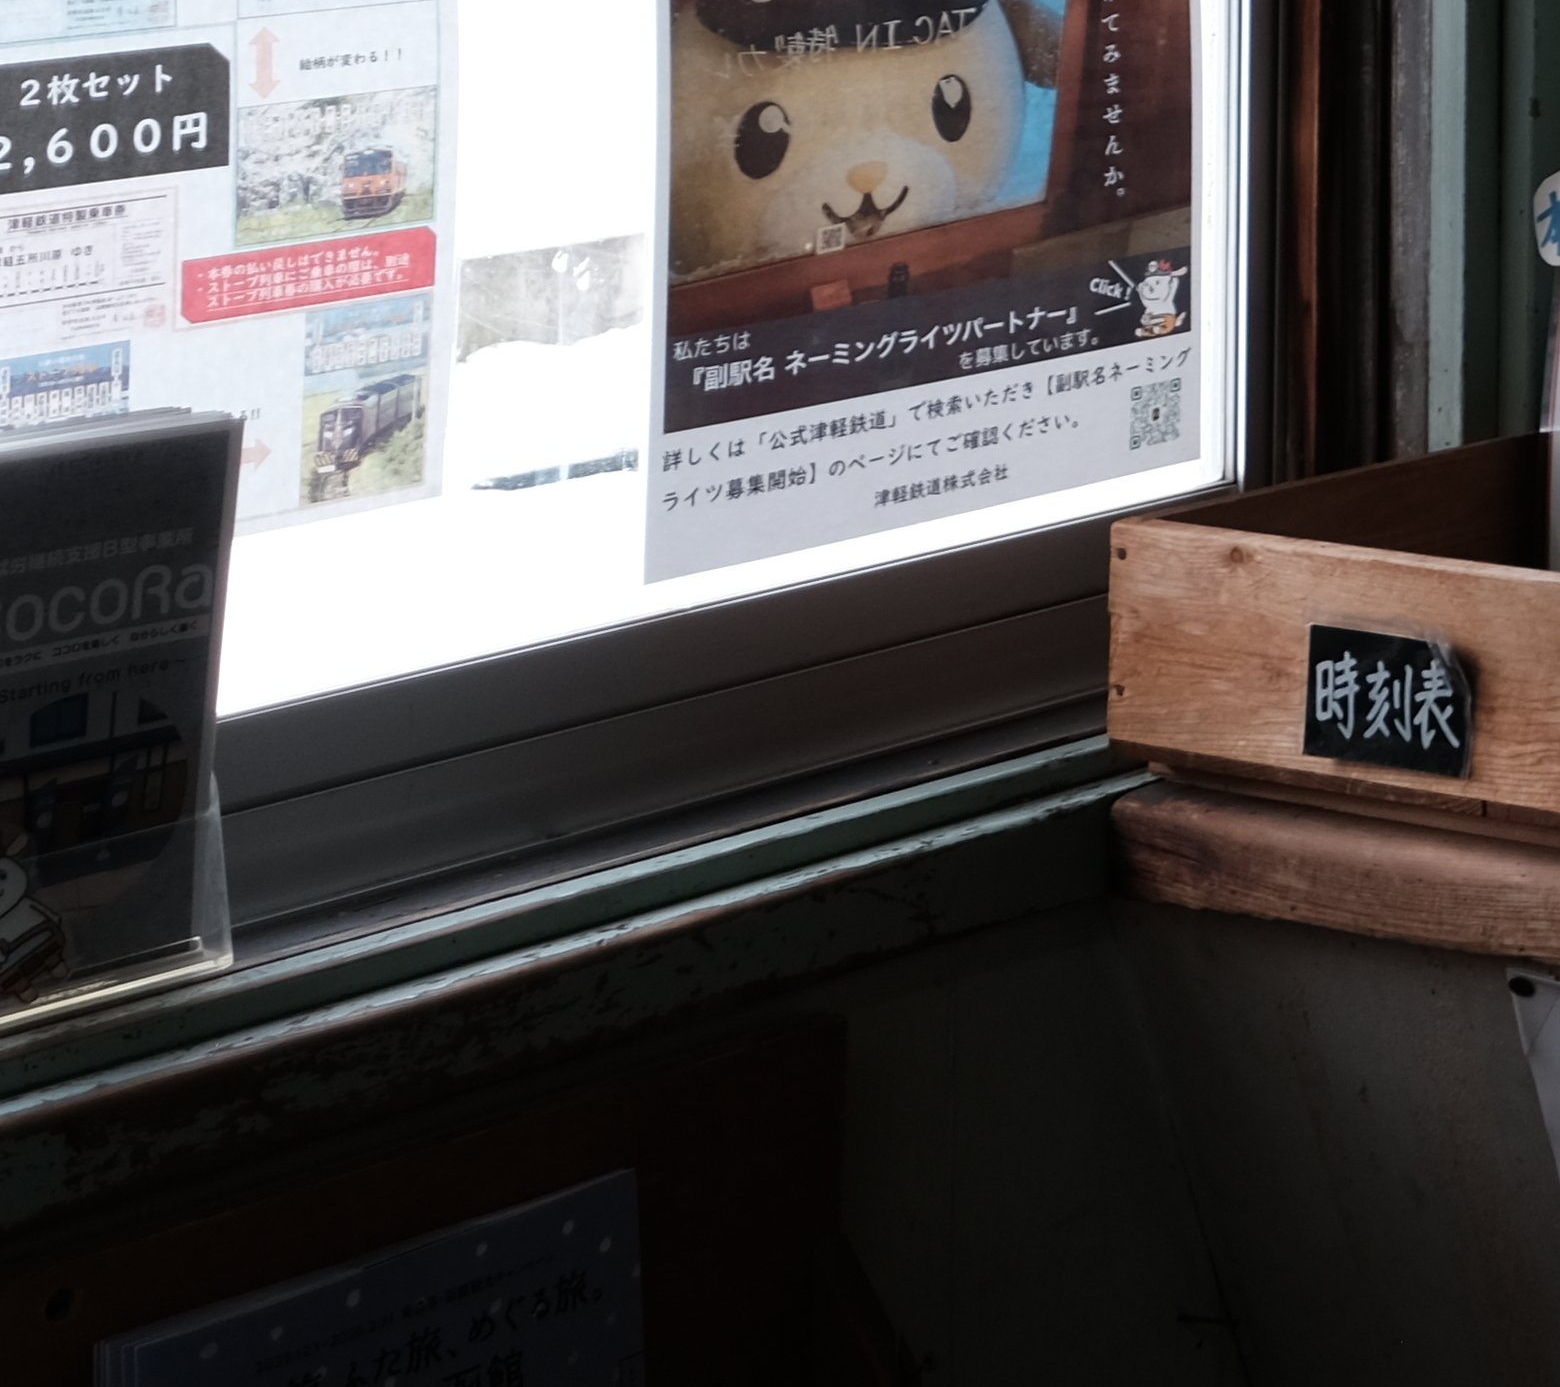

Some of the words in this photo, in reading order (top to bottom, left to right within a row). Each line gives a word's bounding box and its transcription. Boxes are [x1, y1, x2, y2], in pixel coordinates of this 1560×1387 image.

[20, 69, 174, 108] 2枚セット
[673, 330, 750, 361] 私たちは
[959, 330, 1101, 370] を募集しています。
[874, 462, 1009, 507] 津軽鉄道株式会社
[1314, 651, 1461, 750] 時刻表
